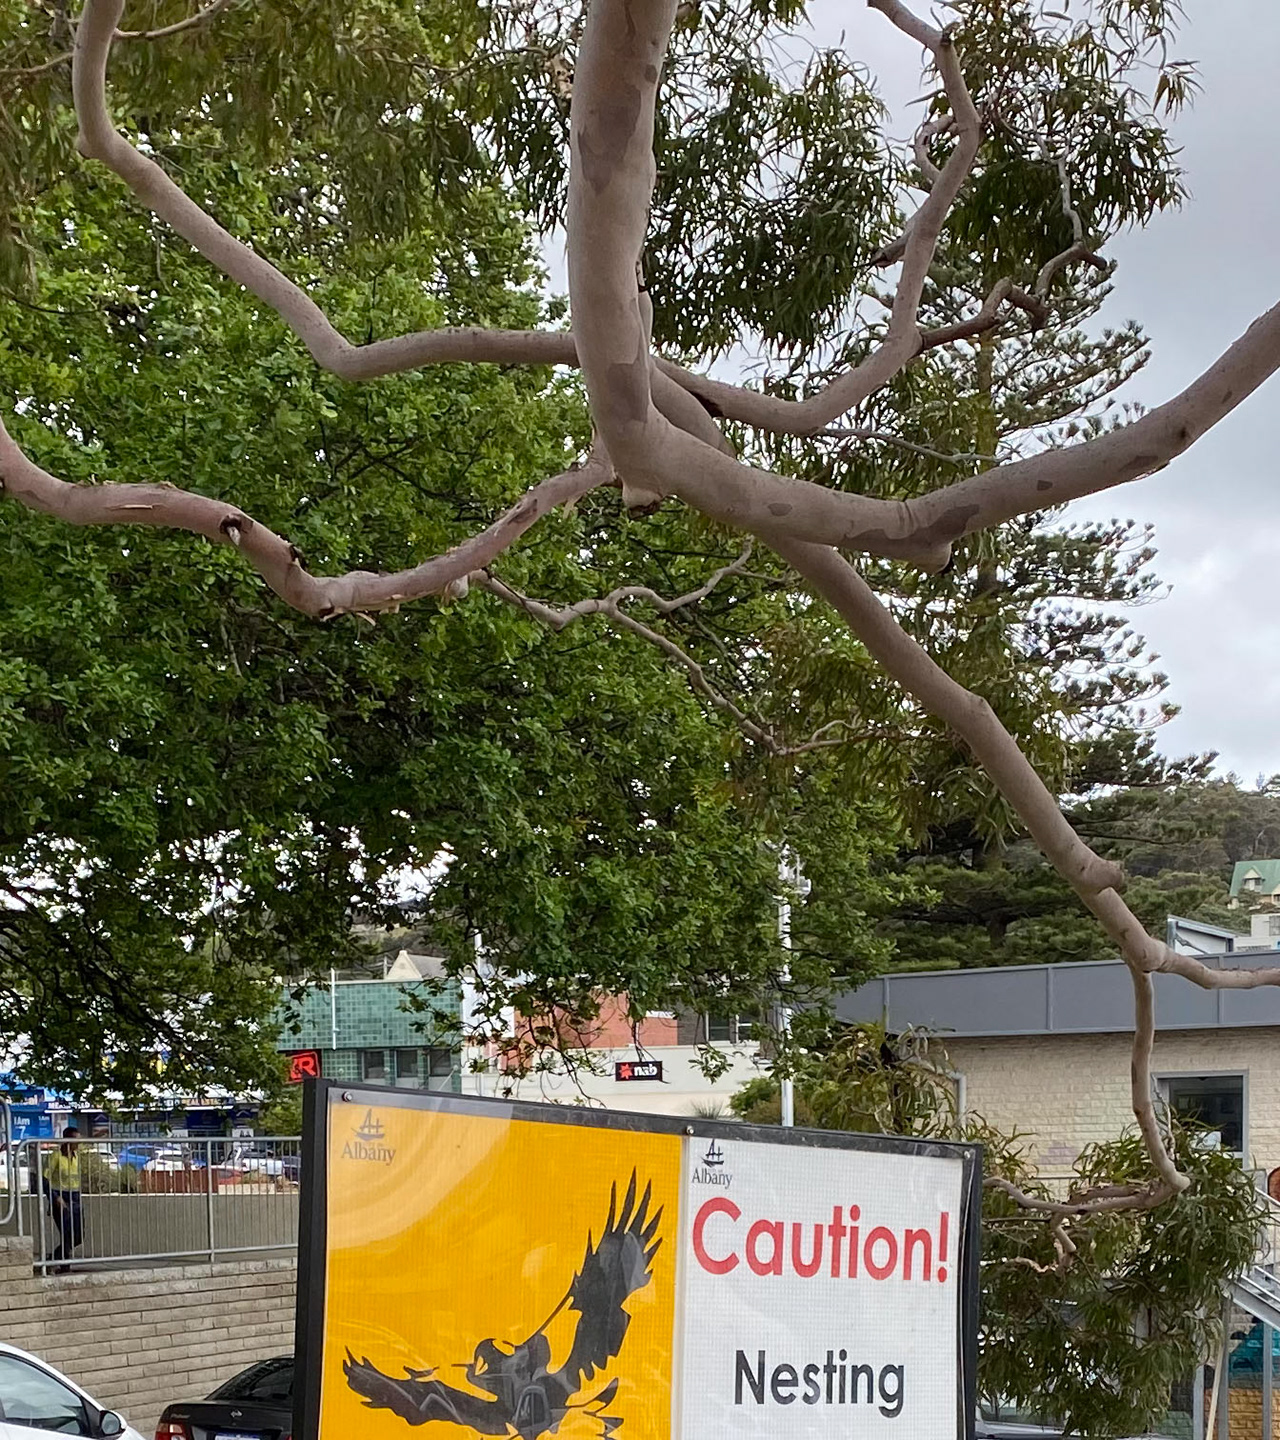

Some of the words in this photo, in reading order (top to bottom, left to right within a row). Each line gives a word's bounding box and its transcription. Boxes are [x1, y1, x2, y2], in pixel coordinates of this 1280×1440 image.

[634, 1063, 658, 1077] nab
[340, 1140, 397, 1166] Albany
[691, 1167, 733, 1189] Albany
[692, 1196, 949, 1283] Caution!
[734, 1349, 905, 1418] Nesting
